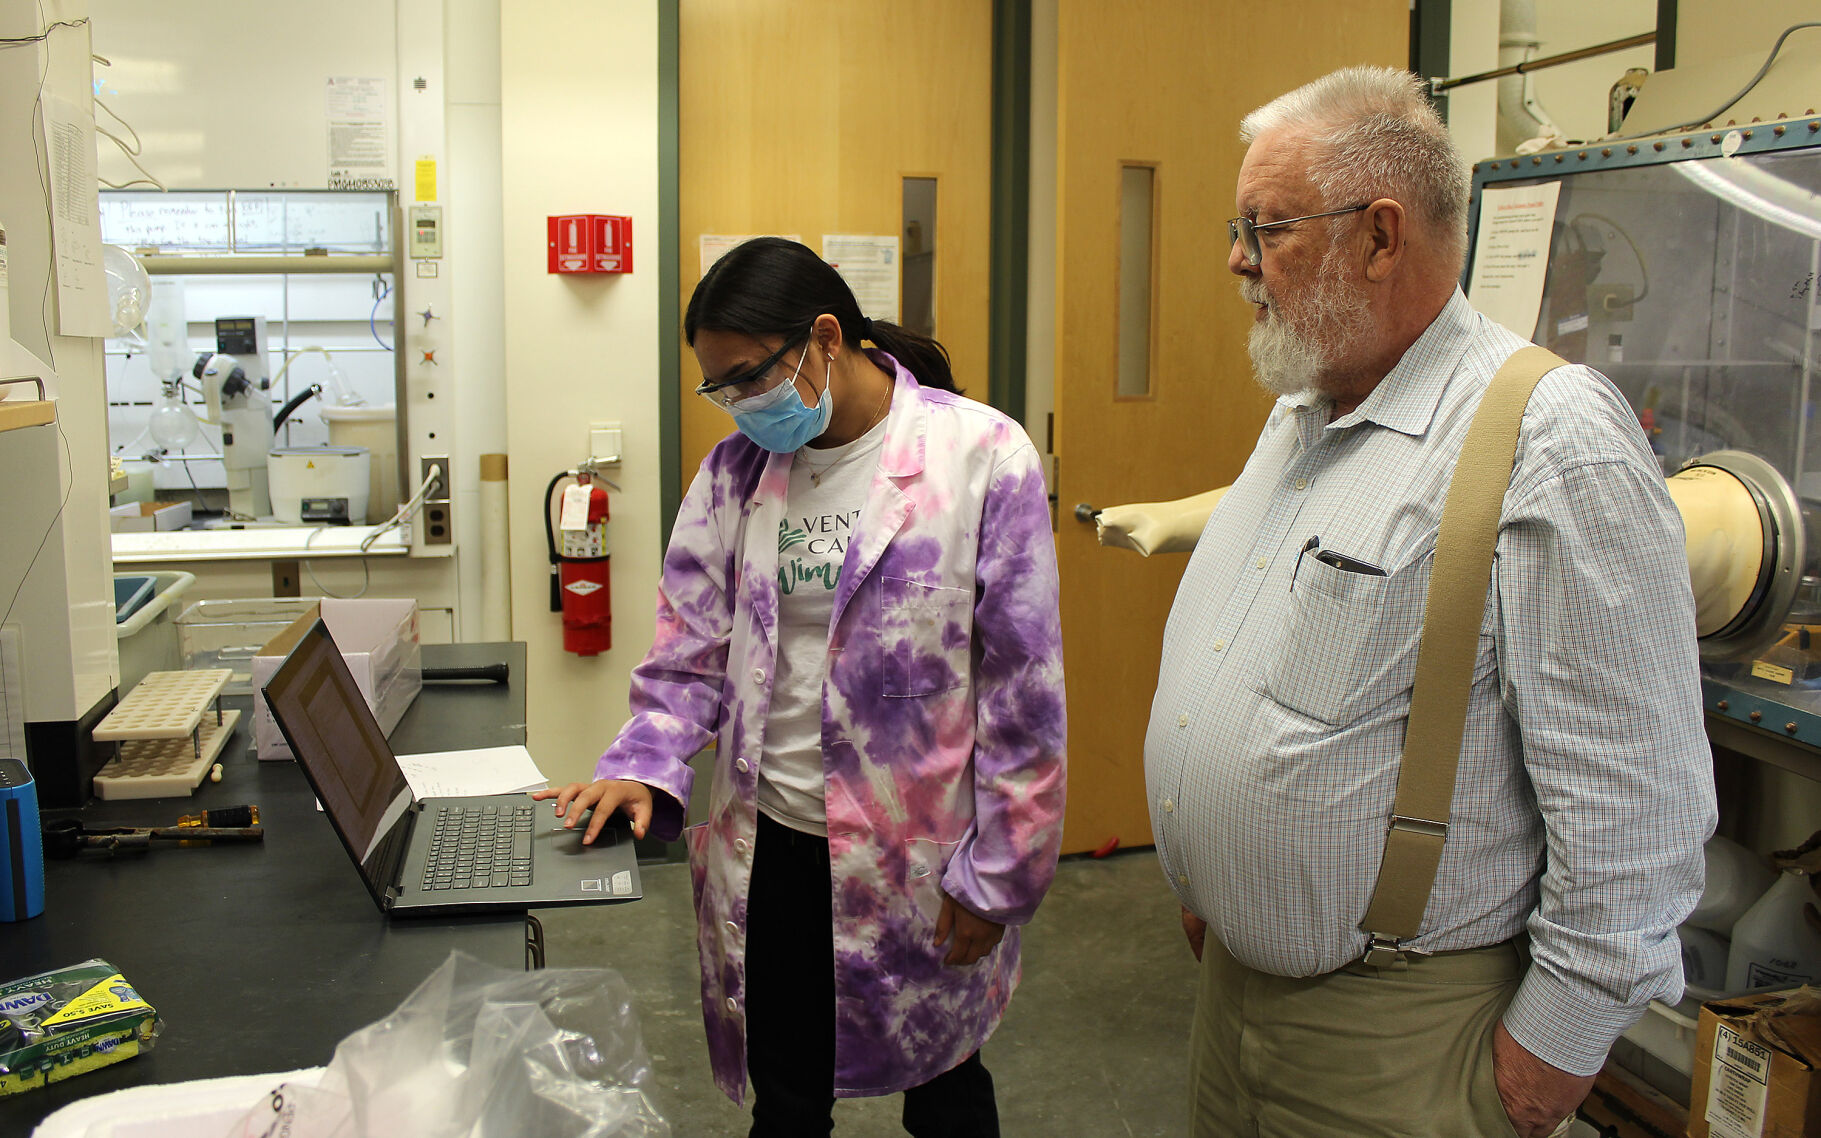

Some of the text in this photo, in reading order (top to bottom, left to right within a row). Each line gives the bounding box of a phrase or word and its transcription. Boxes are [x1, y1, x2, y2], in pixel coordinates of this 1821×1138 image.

[808, 536, 850, 554] CA
[89, 1003, 114, 1013] SAVE
[45, 1033, 90, 1052] HEAVY DUTY
